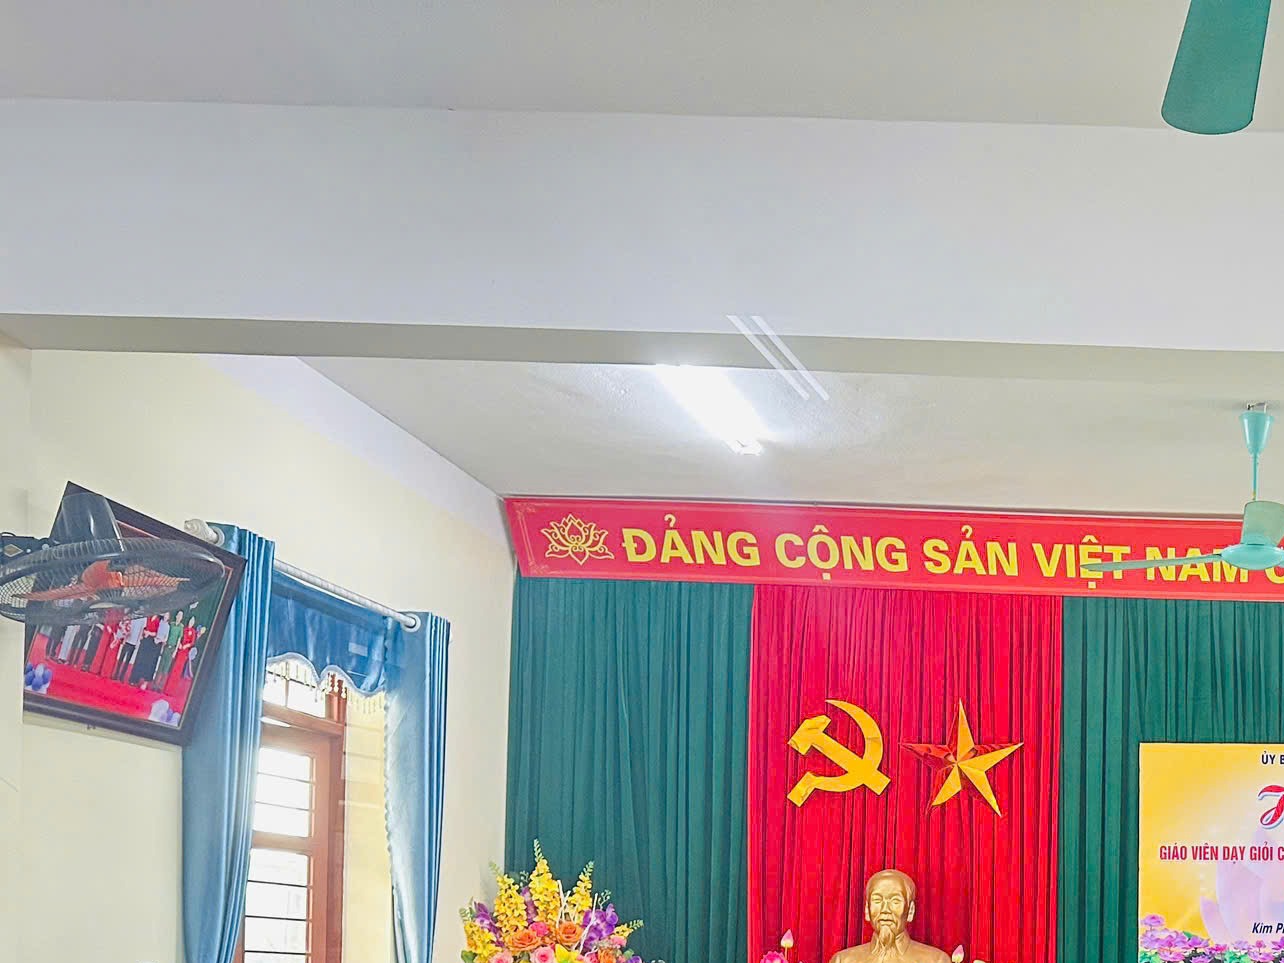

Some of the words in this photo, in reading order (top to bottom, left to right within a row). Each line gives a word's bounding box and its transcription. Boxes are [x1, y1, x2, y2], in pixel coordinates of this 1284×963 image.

[622, 514, 761, 567] ĐẢNG
[774, 525, 908, 580] CỘNG
[922, 525, 1018, 577] SẢN
[1031, 534, 1131, 589] VIỆT
[1145, 546, 1249, 583] NAM
[1261, 750, 1276, 765] ỦY
[1159, 843, 1188, 860] GIÁO
[1191, 843, 1219, 860] VIÊN
[1222, 846, 1246, 864] DẠY
[1249, 842, 1273, 861] GIỎI
[1252, 922, 1273, 934] Kim
